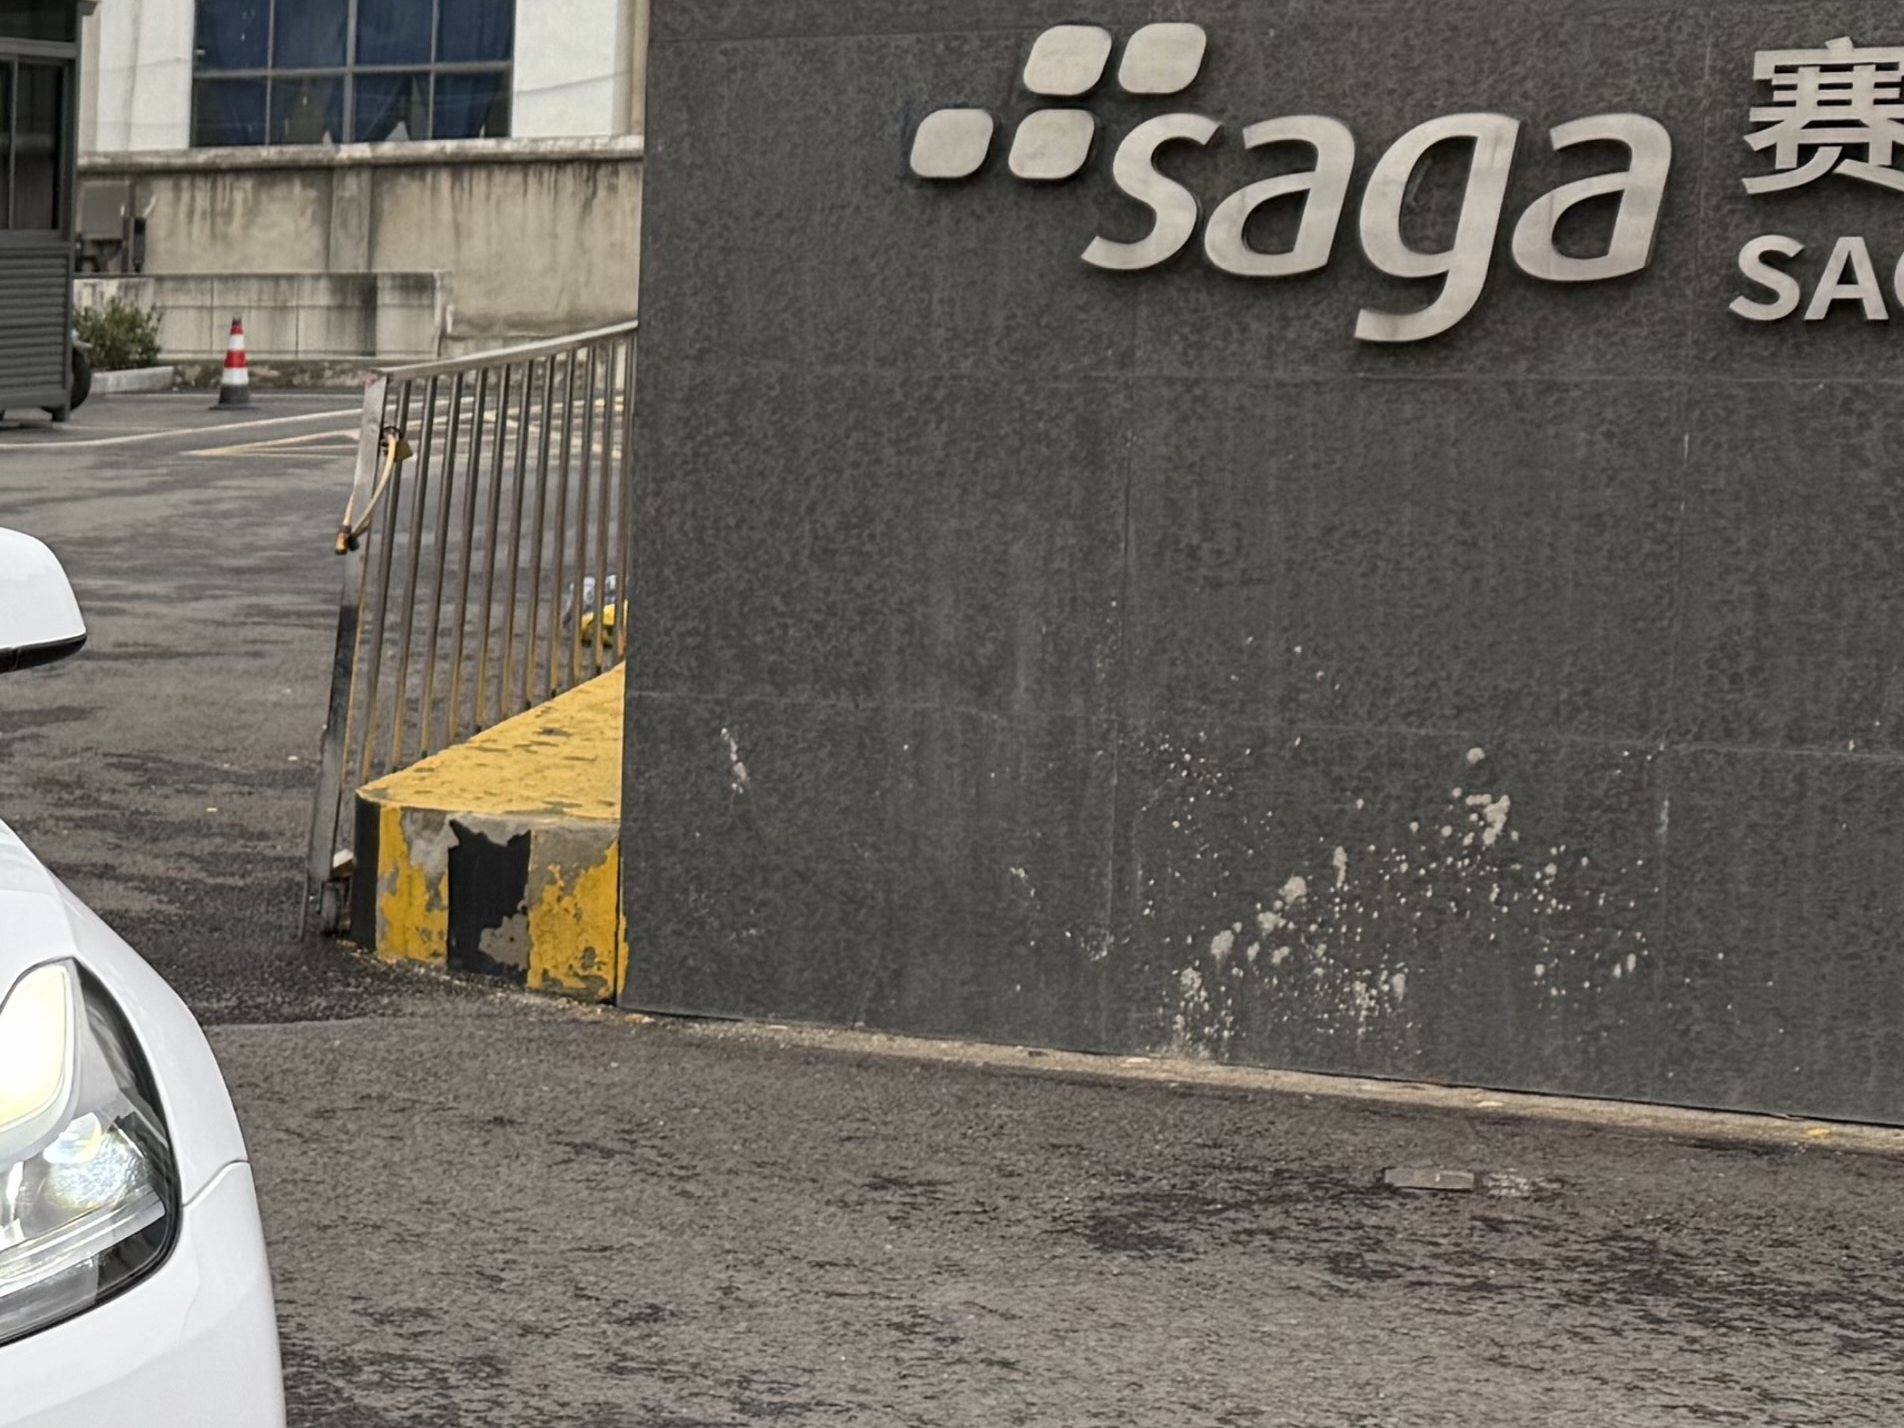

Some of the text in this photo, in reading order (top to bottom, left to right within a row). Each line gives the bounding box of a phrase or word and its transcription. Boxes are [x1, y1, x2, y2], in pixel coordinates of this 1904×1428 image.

[1741, 35, 1904, 195] 赛
[1080, 111, 1673, 343] saga
[1728, 234, 1904, 321] SA
